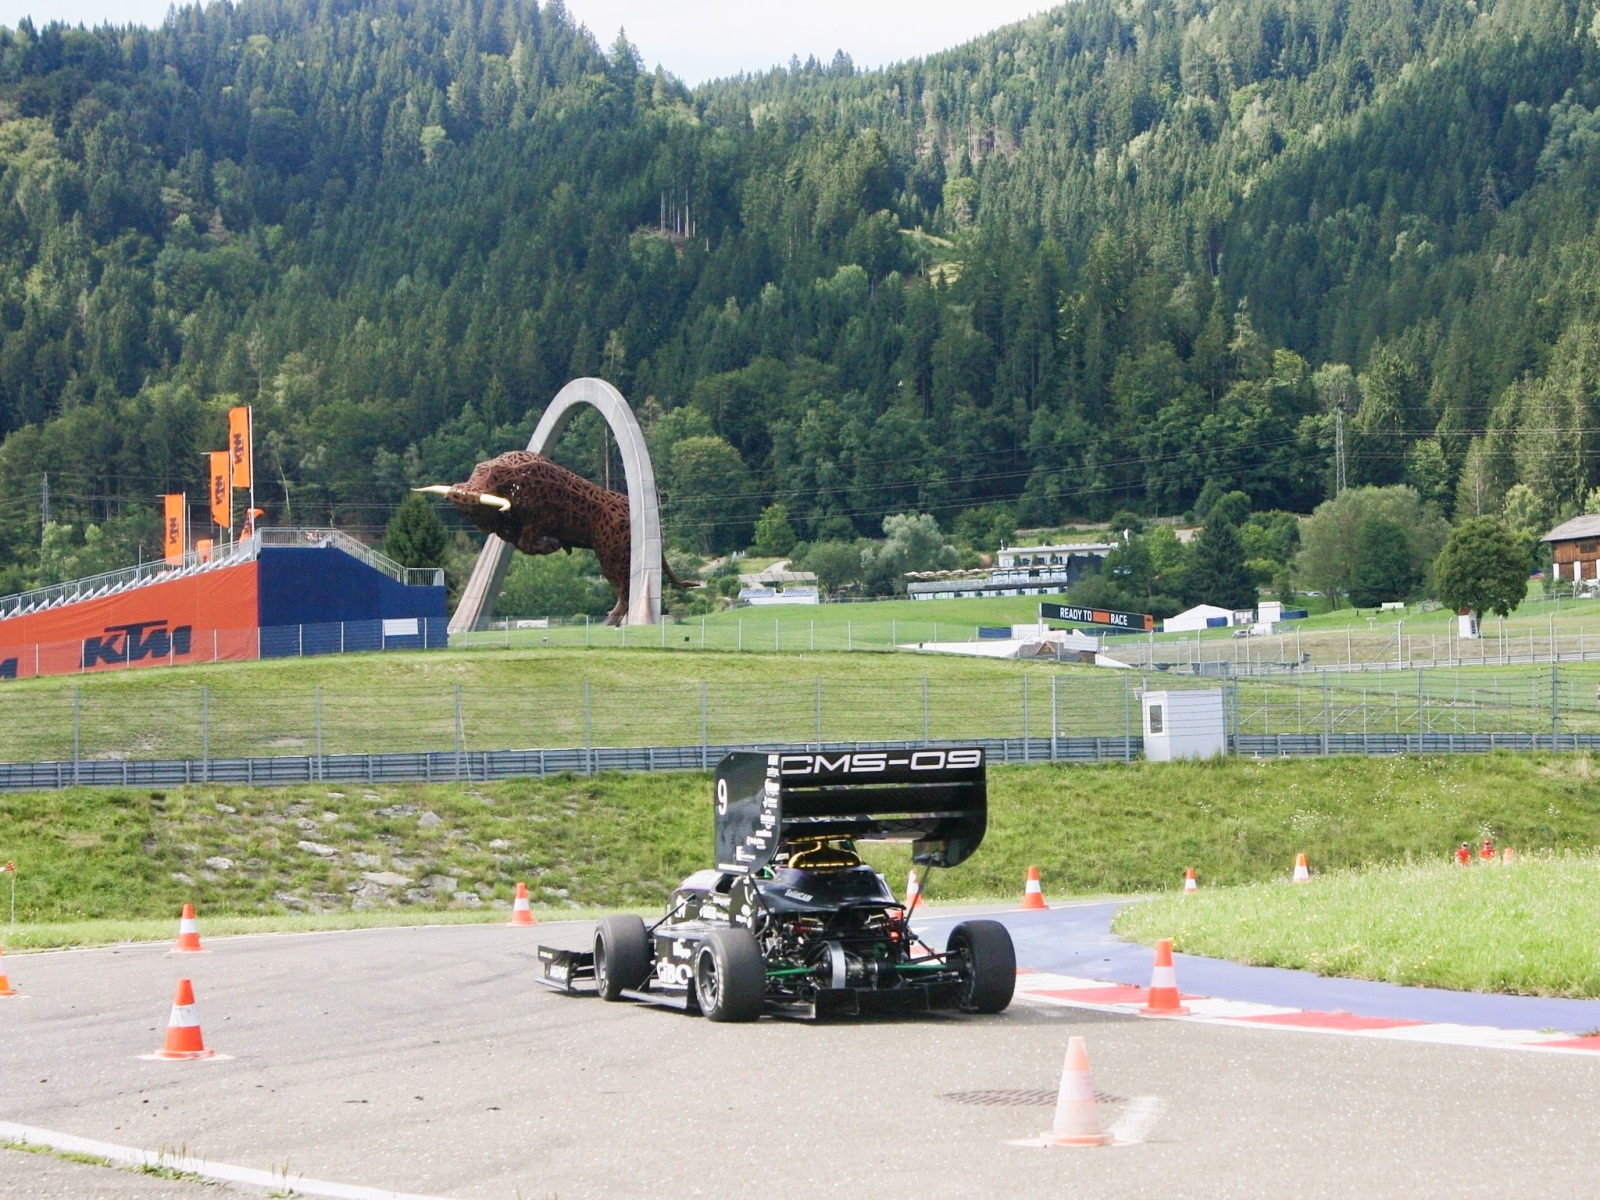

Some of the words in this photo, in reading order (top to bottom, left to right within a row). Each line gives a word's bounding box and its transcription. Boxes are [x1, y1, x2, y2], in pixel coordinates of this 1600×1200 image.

[233, 433, 244, 465] KTM
[215, 475, 225, 505] KTM
[169, 517, 179, 545] KTM
[1060, 607, 1082, 621] READY
[1083, 610, 1093, 621] TO
[1110, 613, 1128, 626] RACE
[79, 619, 192, 668] KTM
[780, 750, 982, 775] CMS-09
[717, 778, 728, 816] 9
